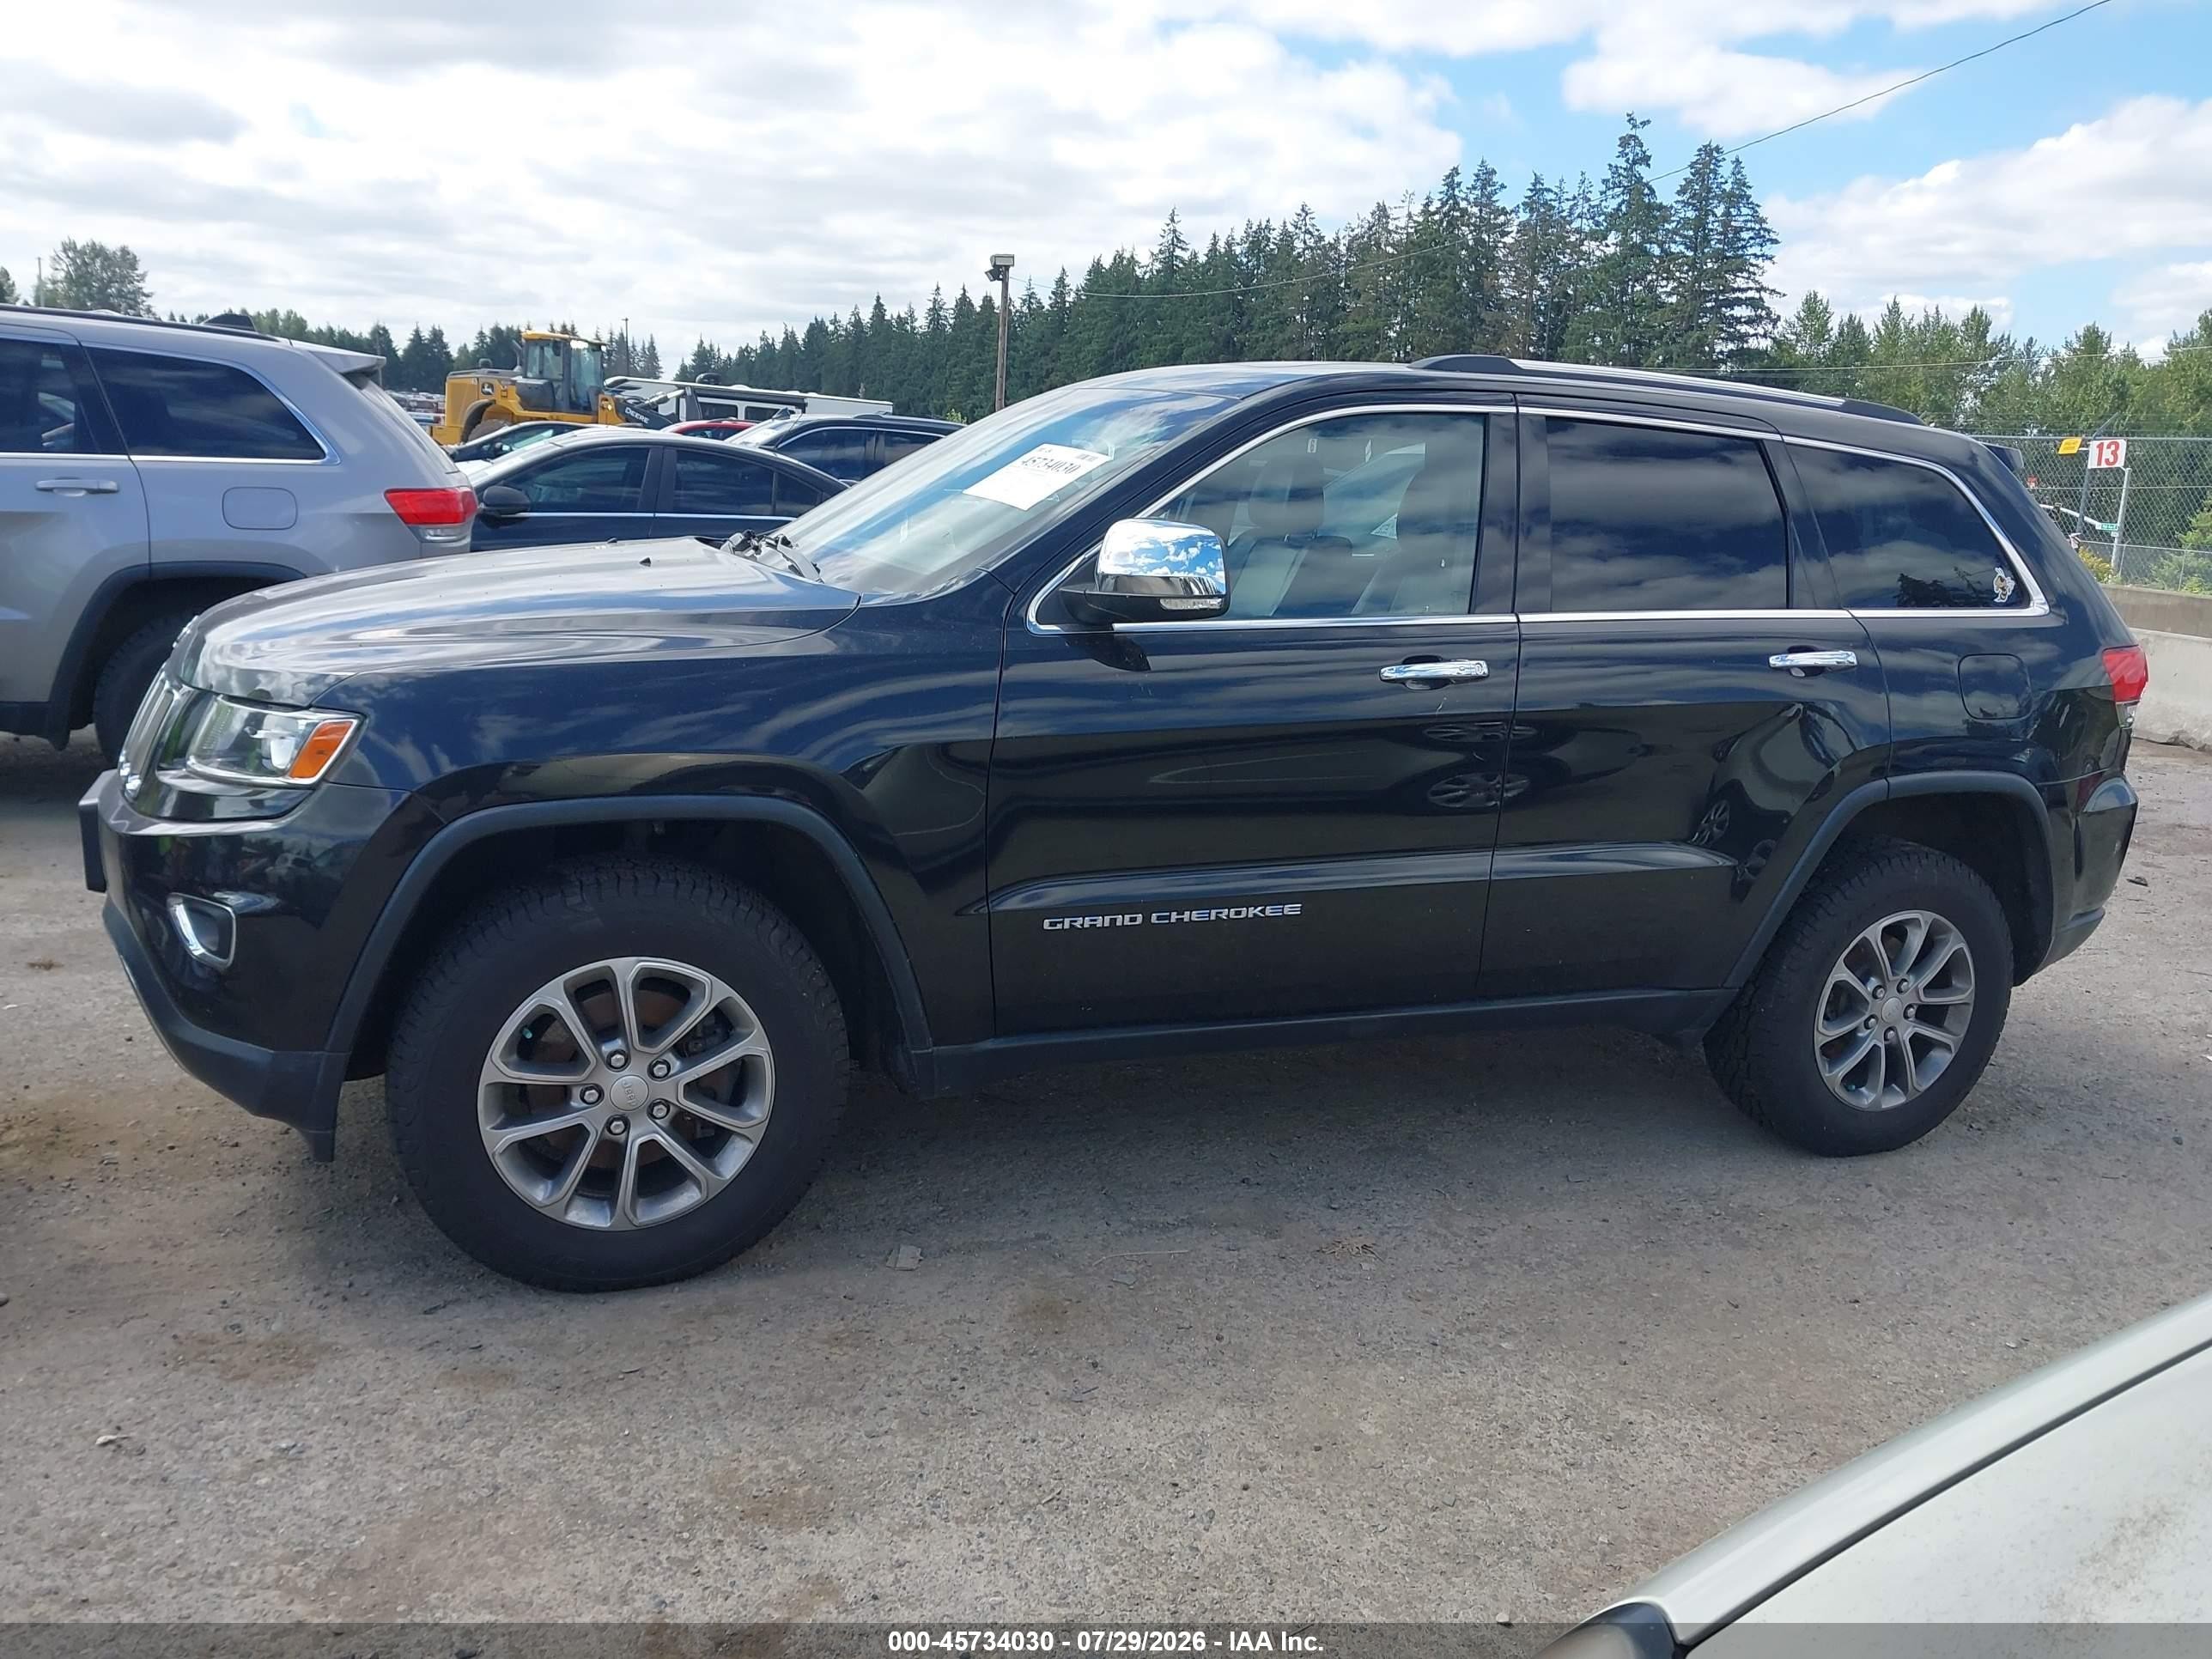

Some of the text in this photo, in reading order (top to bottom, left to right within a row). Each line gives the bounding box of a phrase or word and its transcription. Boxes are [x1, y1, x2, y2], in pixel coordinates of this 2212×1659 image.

[624, 406, 650, 424] DEERE
[2096, 440, 2121, 467] 13
[1042, 902, 1303, 931] GRAND CHEROKEE
[622, 1079, 637, 1107] Jeep
